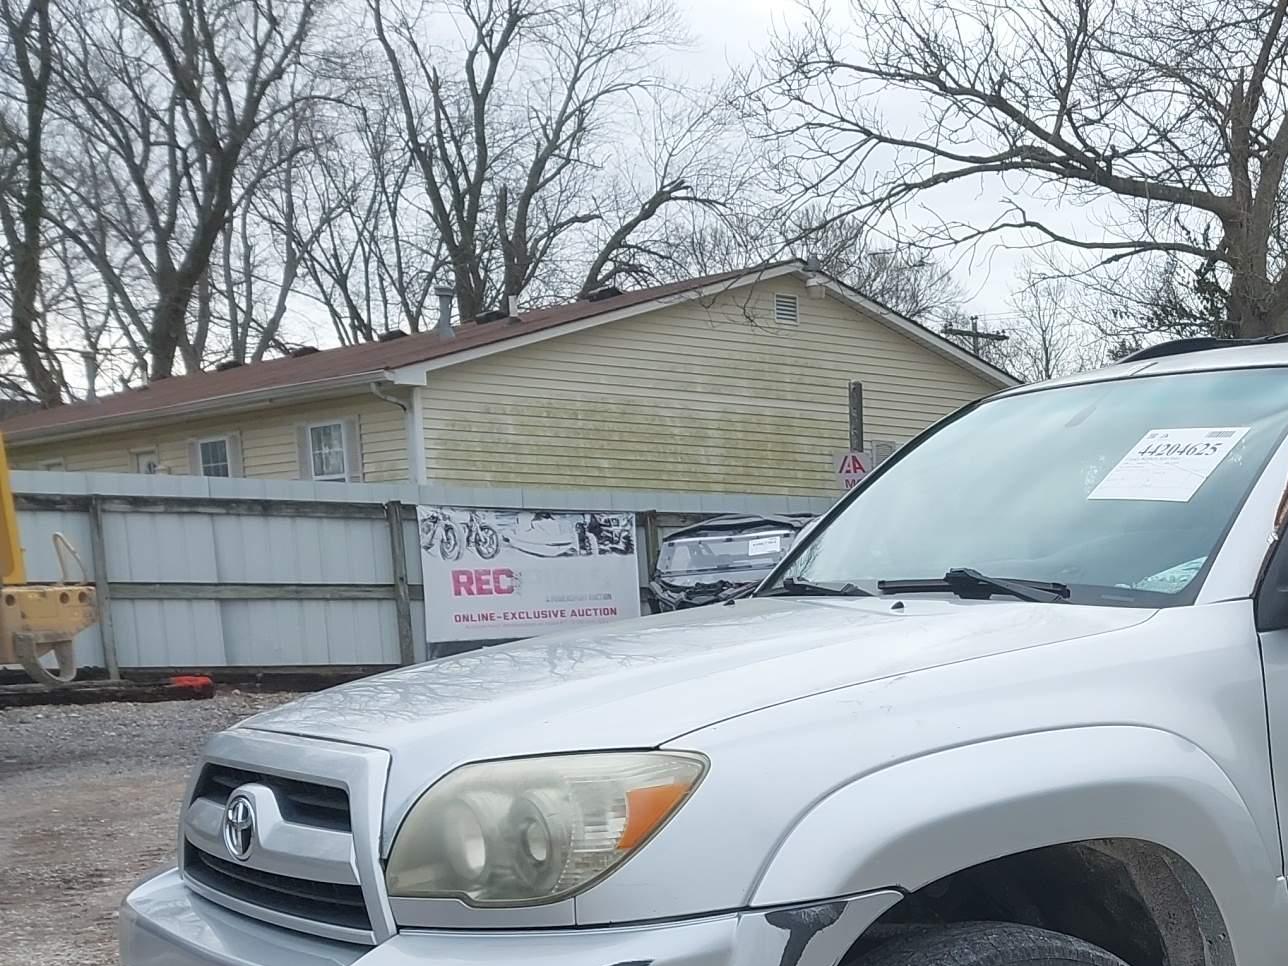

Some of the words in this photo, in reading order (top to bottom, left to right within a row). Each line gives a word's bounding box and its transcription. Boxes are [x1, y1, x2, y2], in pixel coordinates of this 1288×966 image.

[1138, 443, 1223, 456] 44204625
[454, 610, 566, 623] ONLINE-EXCLUSIVE
[571, 607, 616, 617] AUCTION
